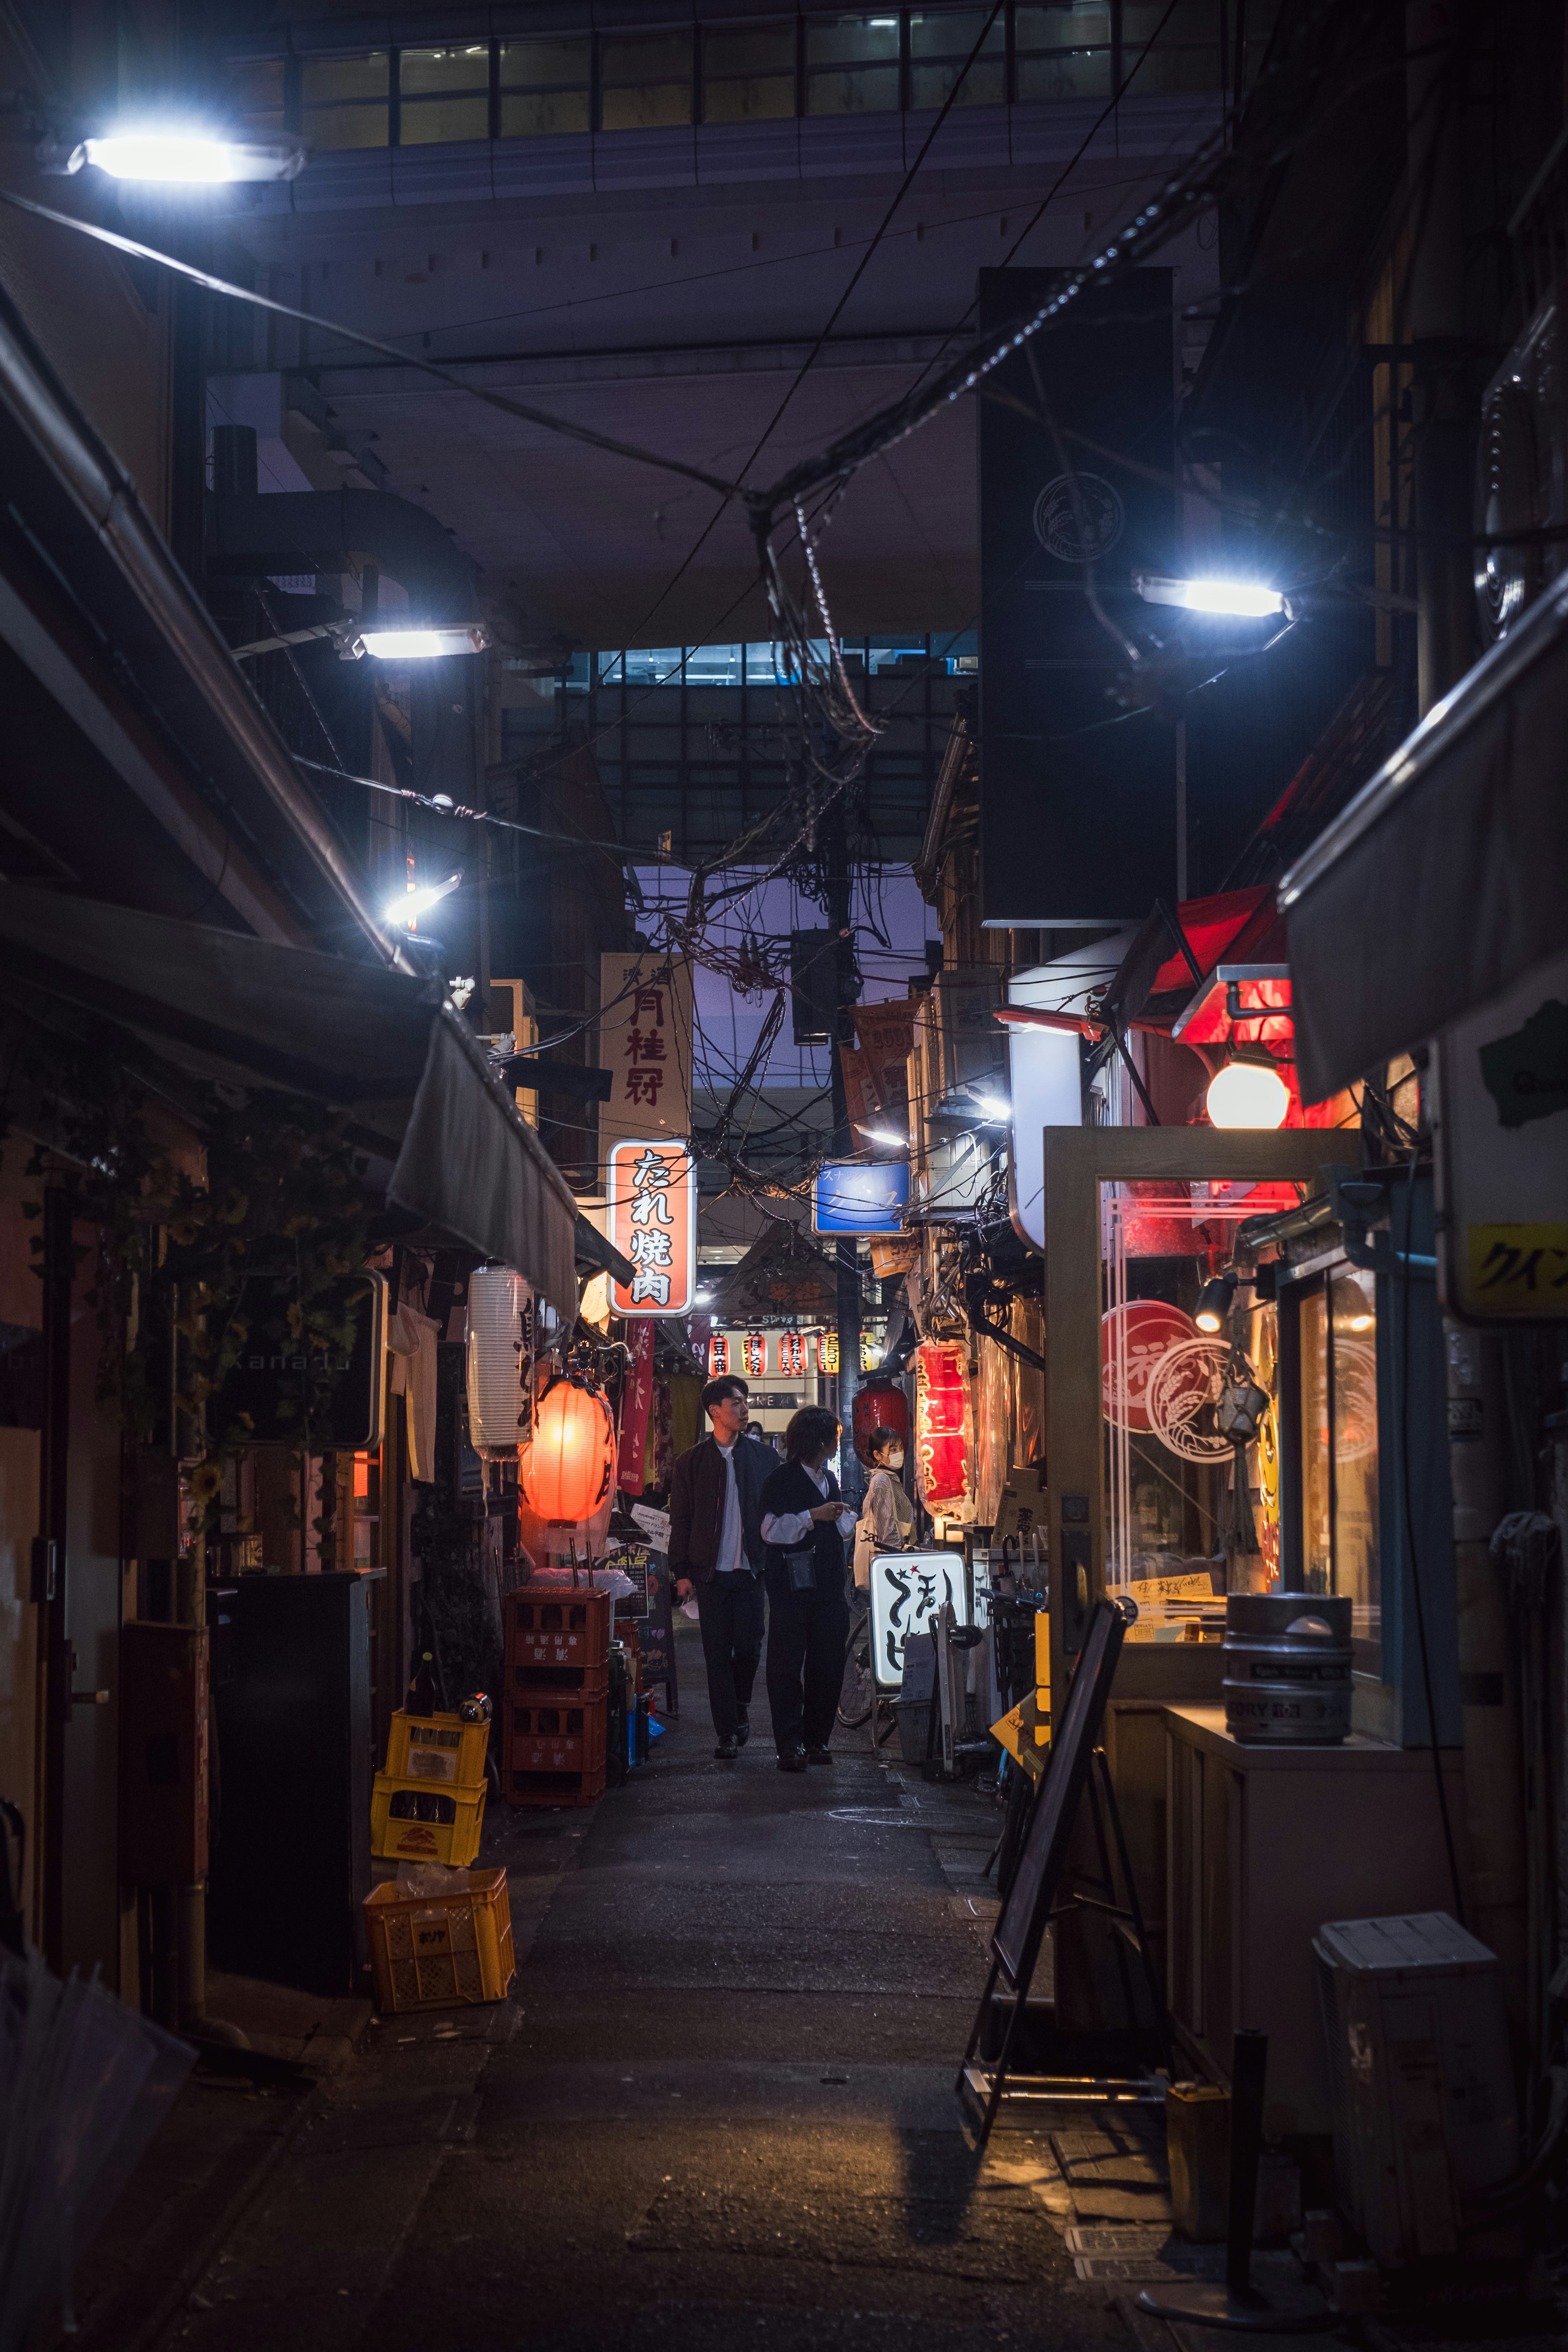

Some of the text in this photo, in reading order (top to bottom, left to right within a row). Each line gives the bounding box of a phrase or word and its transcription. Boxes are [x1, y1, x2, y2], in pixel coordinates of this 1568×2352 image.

[624, 989, 668, 1107] 月桂冠
[630, 1148, 673, 1306] たれ焼肉
[751, 1340, 762, 1373] ほしぐみ
